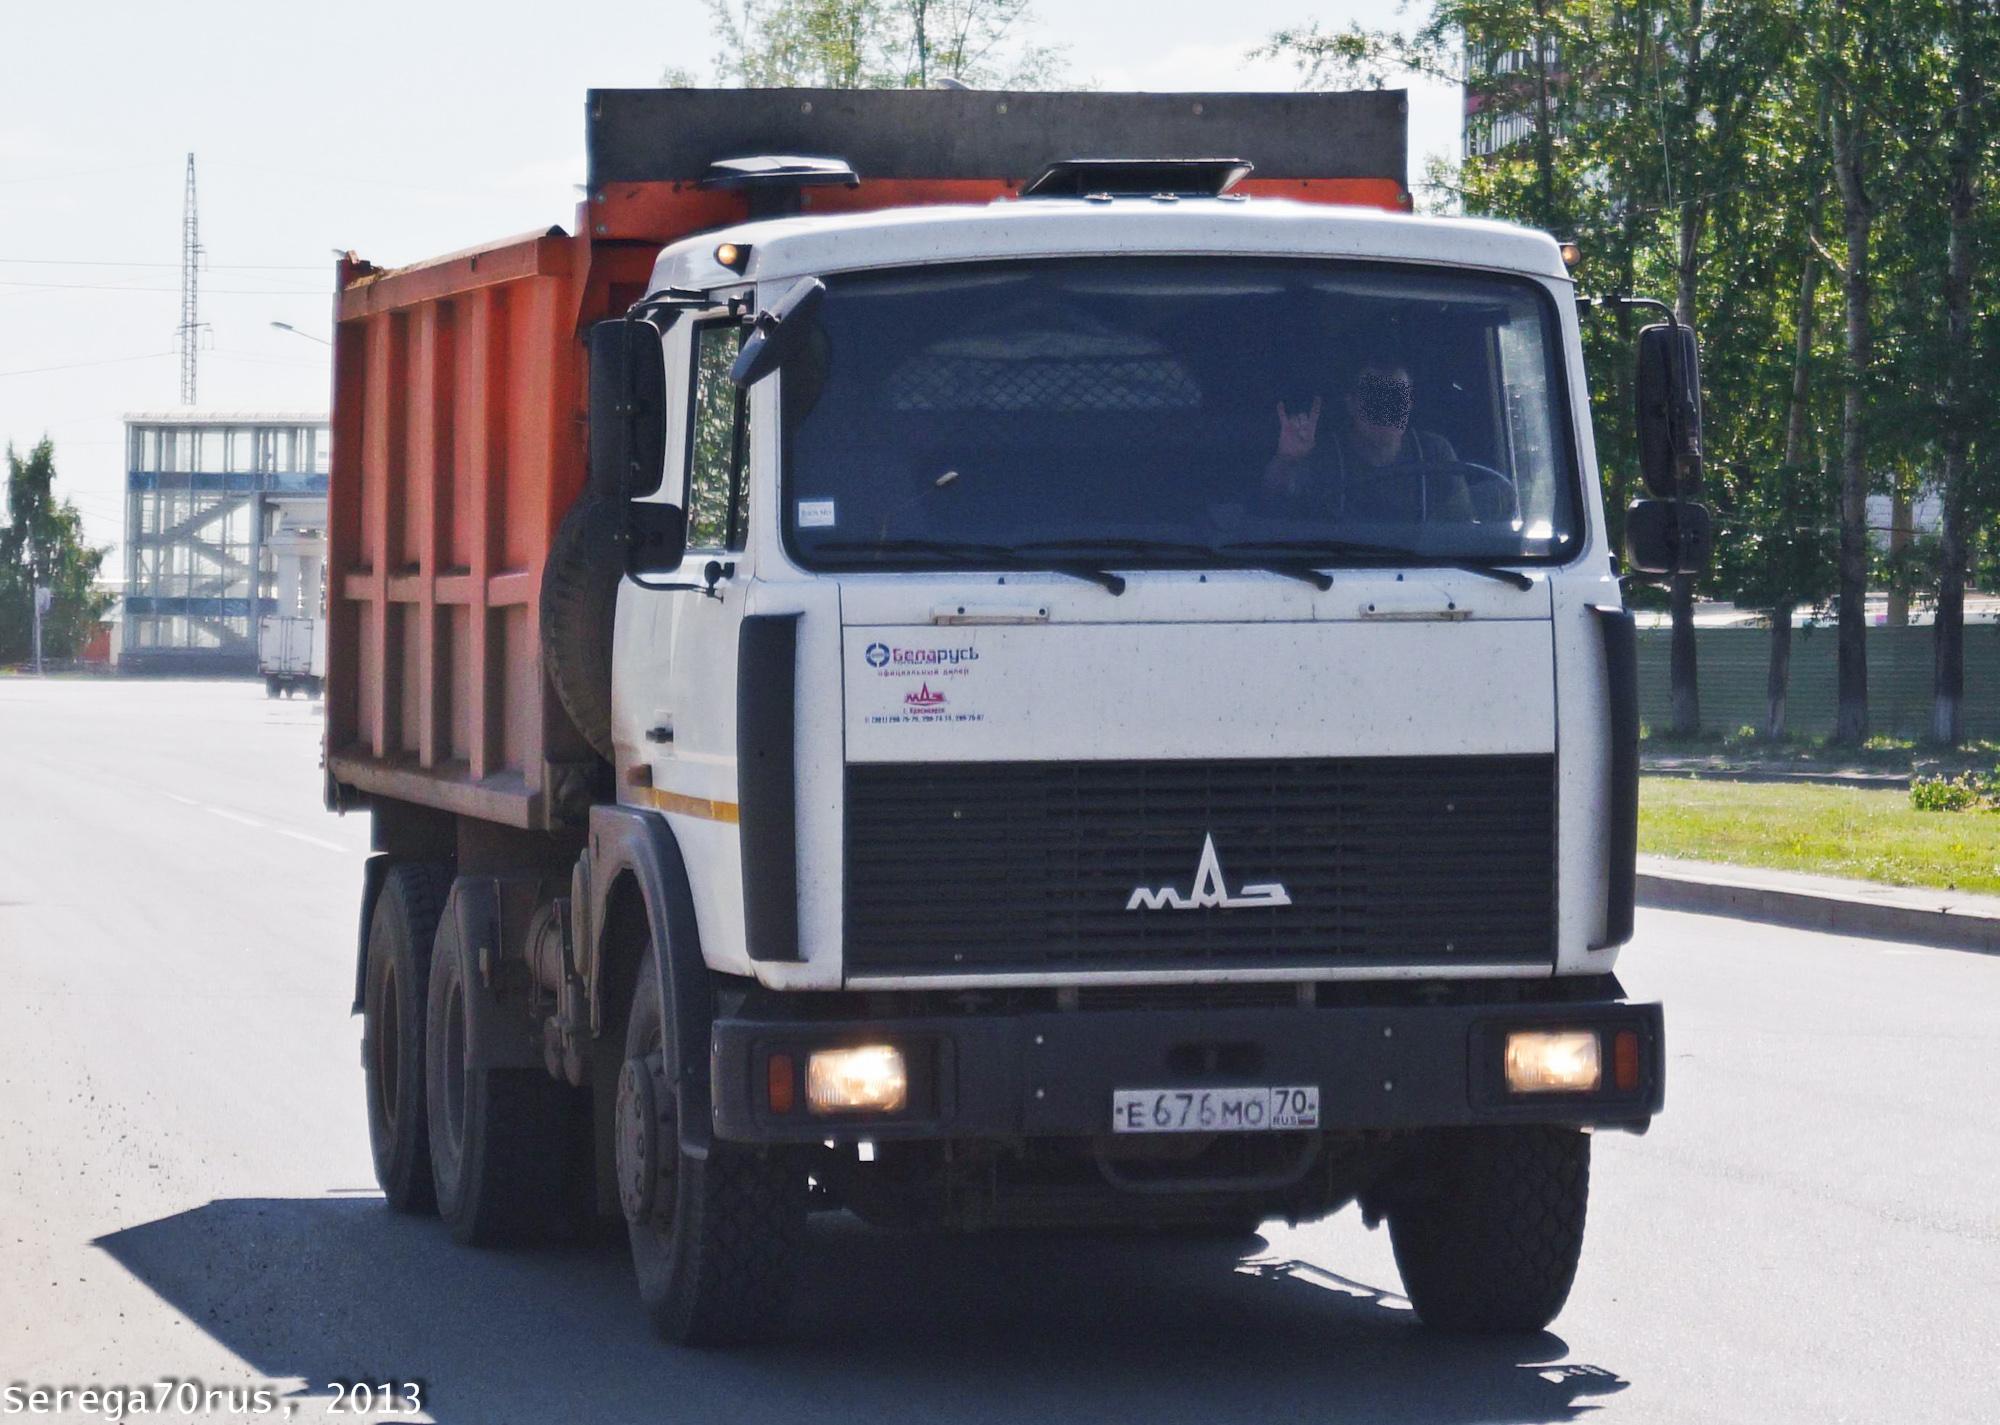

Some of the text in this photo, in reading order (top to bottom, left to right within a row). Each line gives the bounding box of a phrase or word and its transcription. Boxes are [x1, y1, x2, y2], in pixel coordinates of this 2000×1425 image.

[893, 647, 979, 664] Беларусь
[1275, 1090, 1307, 1114] 70
[1272, 1115, 1297, 1125] RUS
